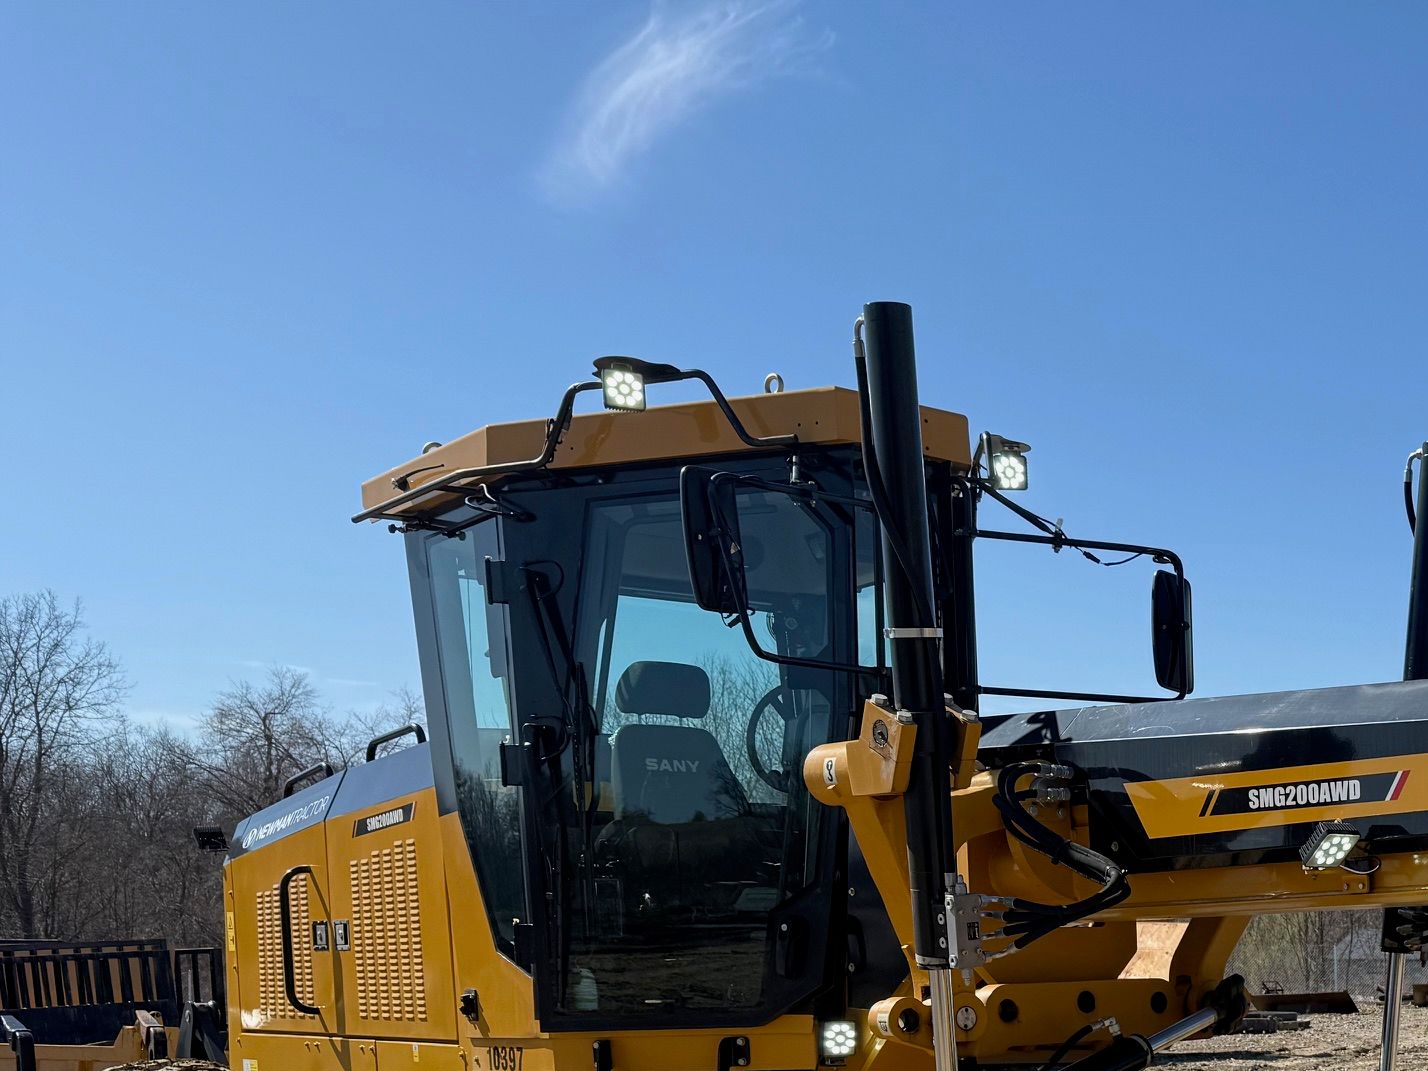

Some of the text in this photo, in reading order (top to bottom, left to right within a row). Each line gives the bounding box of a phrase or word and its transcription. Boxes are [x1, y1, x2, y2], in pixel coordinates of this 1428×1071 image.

[645, 758, 699, 772] SANY
[1248, 780, 1361, 809] SMG200AWD
[366, 808, 404, 832] SMG200AWD
[487, 1045, 524, 1071] 10397
